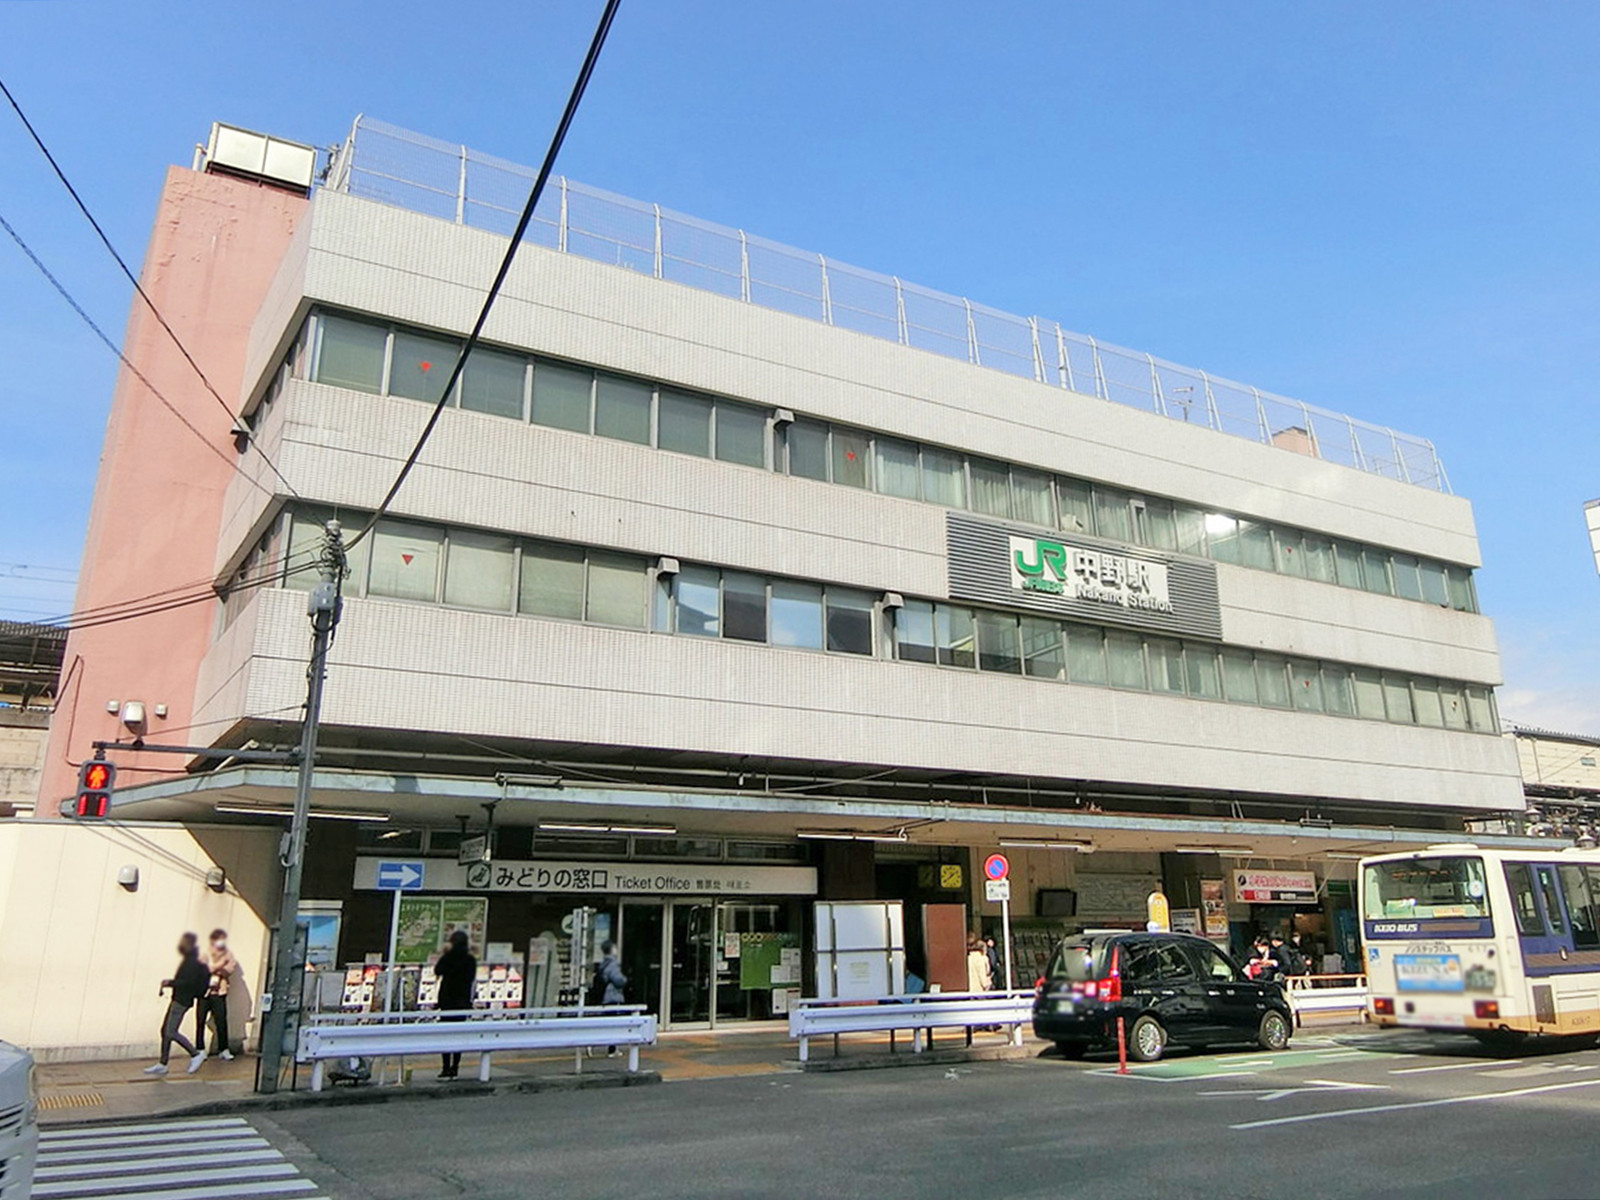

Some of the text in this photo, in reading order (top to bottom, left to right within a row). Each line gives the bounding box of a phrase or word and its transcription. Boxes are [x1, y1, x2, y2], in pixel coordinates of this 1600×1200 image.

[1014, 540, 1067, 581] JR
[1074, 550, 1150, 594] 中野駅
[1076, 584, 1173, 613] Nakano Station
[496, 868, 608, 889] みどりの窓口
[614, 875, 690, 890] Ticket Office
[1374, 924, 1418, 933] KEIO BUS
